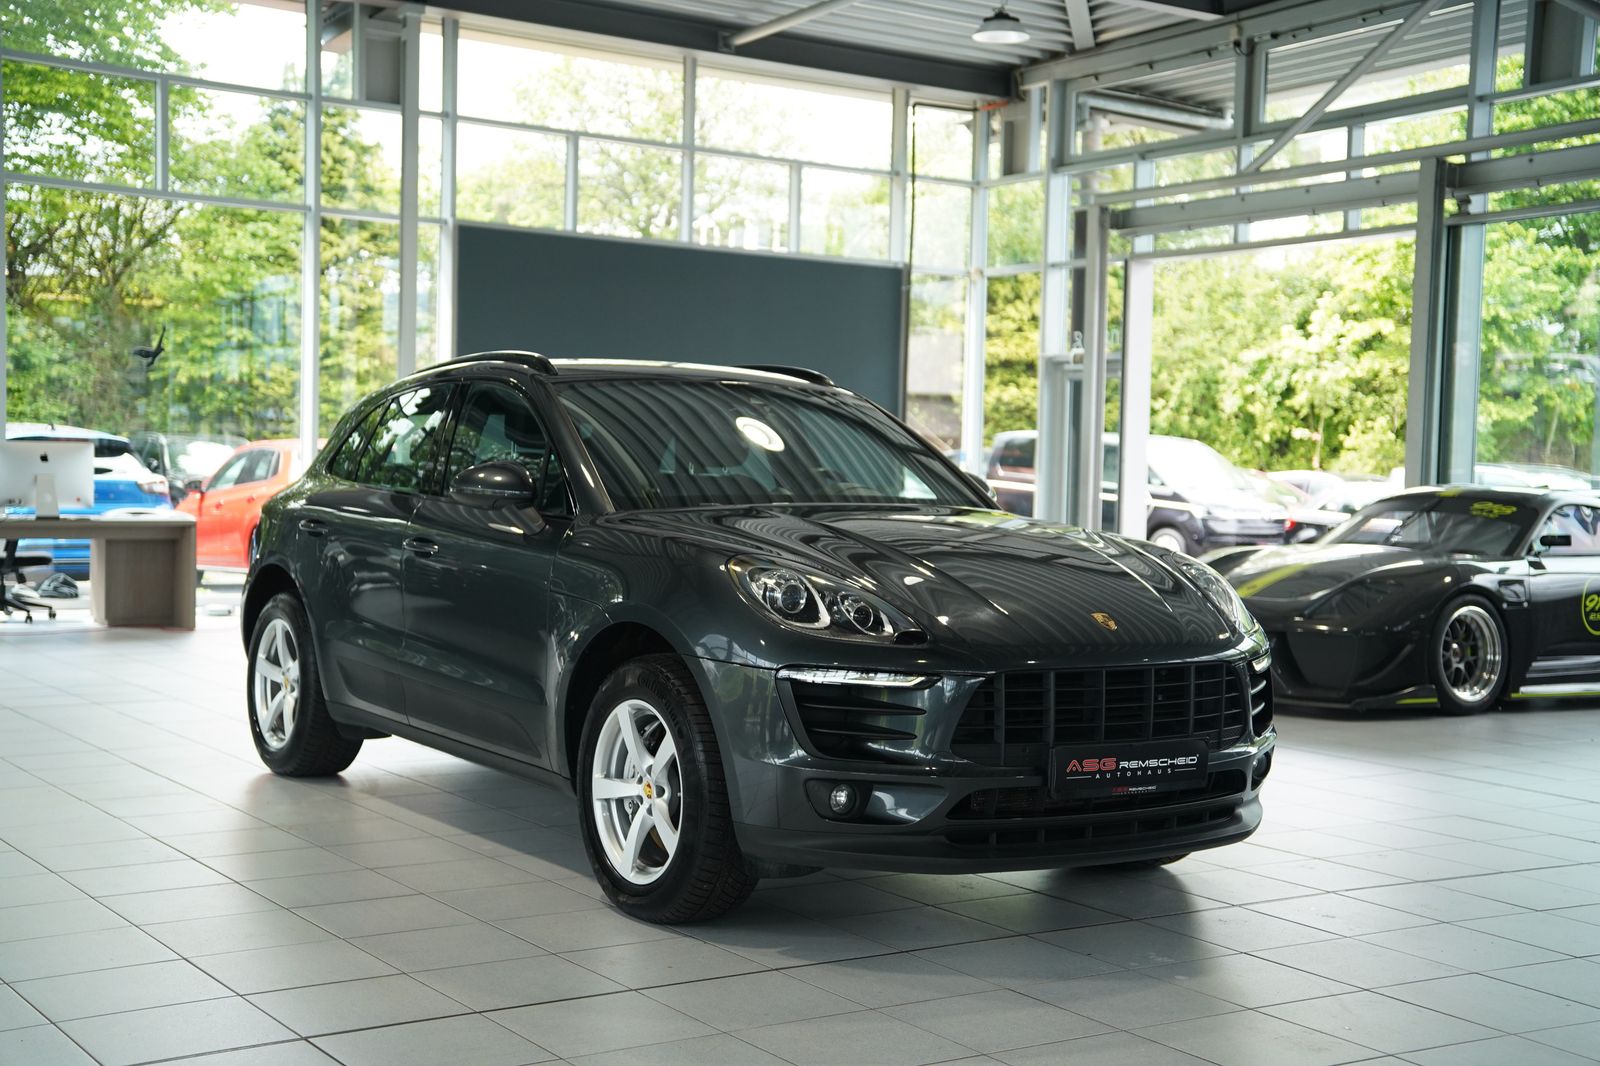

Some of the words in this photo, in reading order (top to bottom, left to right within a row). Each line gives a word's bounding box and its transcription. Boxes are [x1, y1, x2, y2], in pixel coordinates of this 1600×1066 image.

[1066, 757, 1117, 773] ASG
[1119, 756, 1198, 769] REMSCHEID
[1095, 768, 1172, 779] AUTOHAUS
